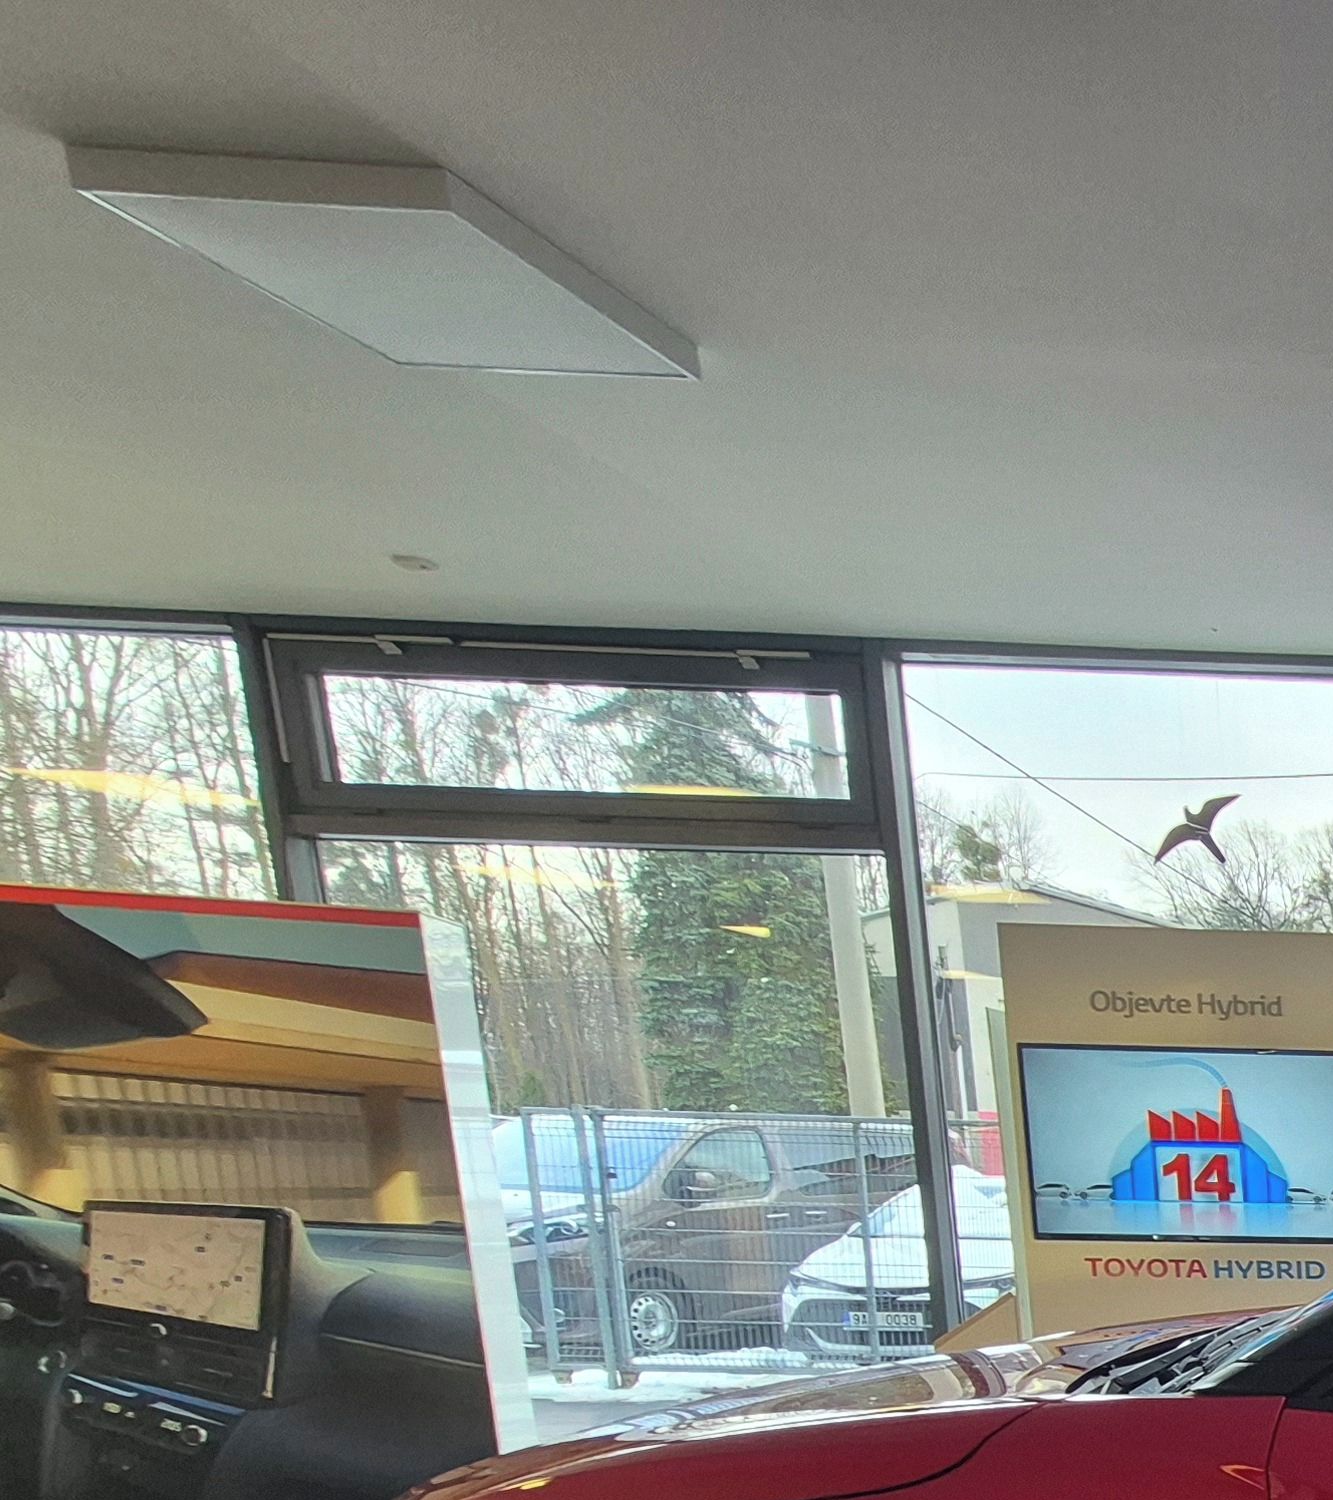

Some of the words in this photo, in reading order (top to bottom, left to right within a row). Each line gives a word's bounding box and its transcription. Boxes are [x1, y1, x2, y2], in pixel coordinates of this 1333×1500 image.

[1090, 990, 1191, 1018] Objevte
[1197, 993, 1282, 1021] Hybrid
[1162, 1153, 1236, 1202] 14
[1084, 1257, 1207, 1278] TOYOTA
[1214, 1259, 1325, 1280] HYBRID
